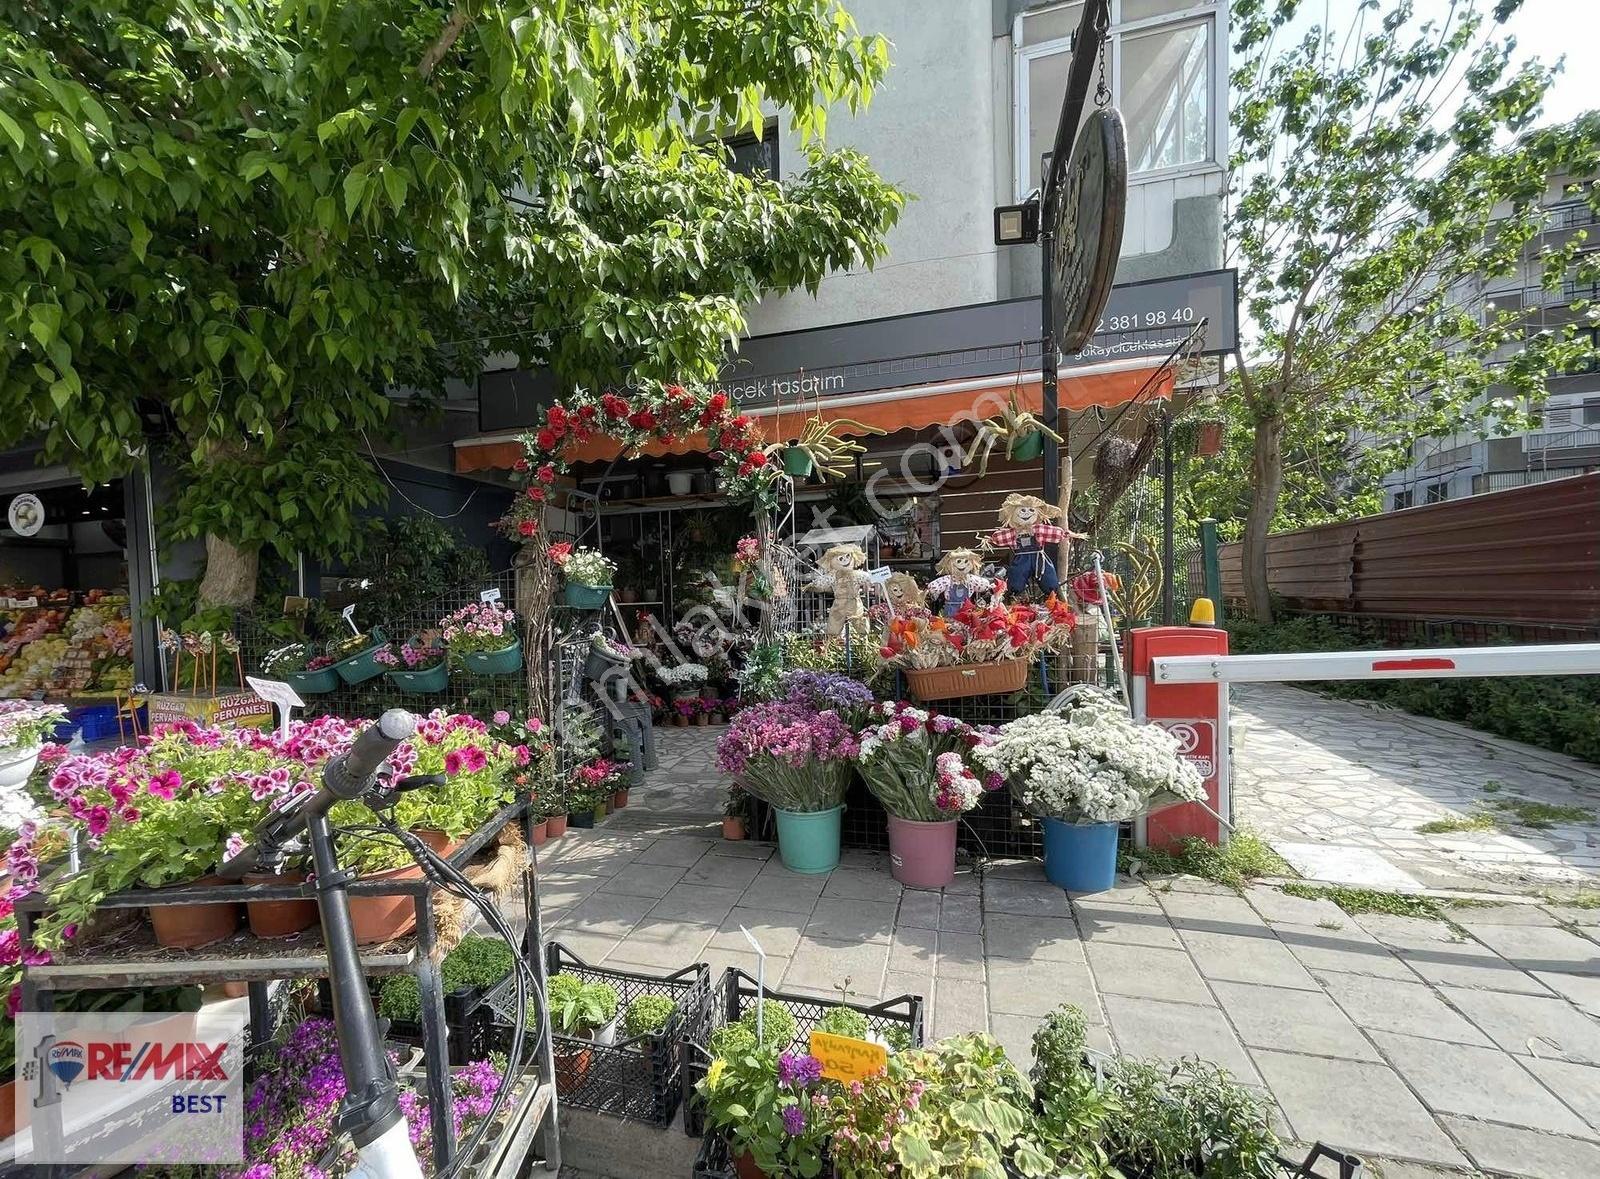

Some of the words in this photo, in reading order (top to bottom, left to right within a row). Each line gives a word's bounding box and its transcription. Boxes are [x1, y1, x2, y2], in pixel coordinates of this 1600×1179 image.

[1110, 314, 1138, 331] 381
[1145, 310, 1167, 326] 98
[1172, 306, 1194, 322] 40
[213, 701, 271, 723] PERVANESİ
